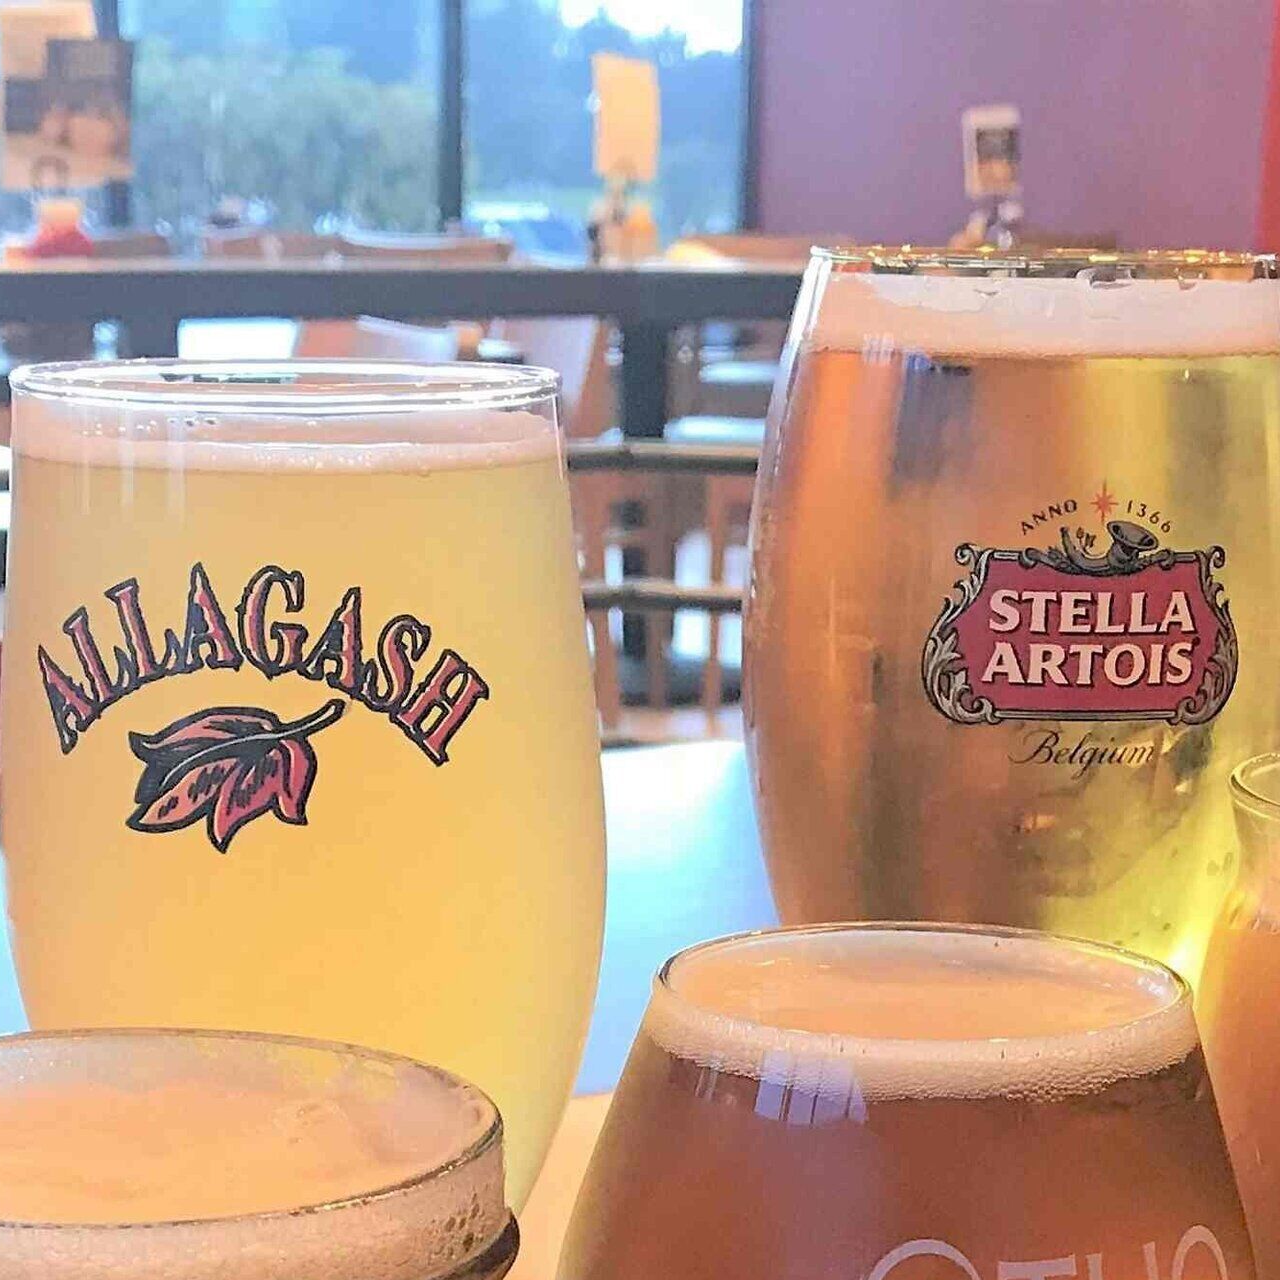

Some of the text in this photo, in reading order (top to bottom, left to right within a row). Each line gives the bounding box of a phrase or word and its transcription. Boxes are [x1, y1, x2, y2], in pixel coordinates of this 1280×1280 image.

[1020, 499, 1173, 536] ANNO 1366
[988, 589, 1197, 635] STELLA
[37, 562, 490, 766] ALLAGASH
[981, 641, 1196, 688] ARTOIS
[1008, 728, 1156, 780] Belgium
